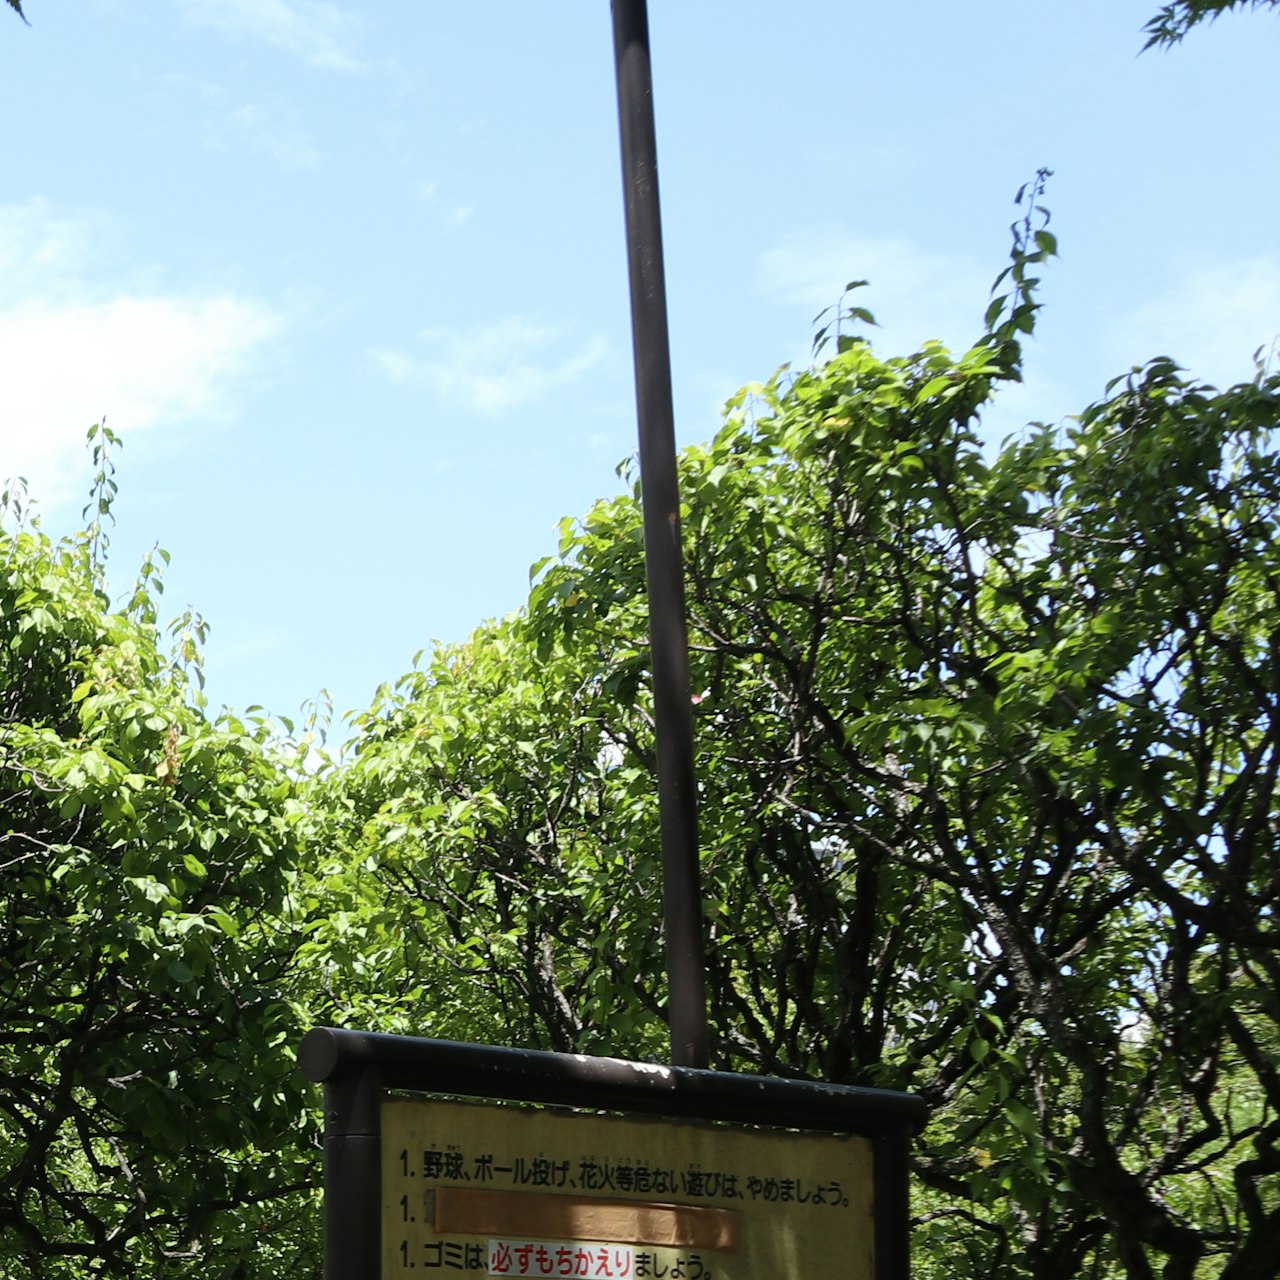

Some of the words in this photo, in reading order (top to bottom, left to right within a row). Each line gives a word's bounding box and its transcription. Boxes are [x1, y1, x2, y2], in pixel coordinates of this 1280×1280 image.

[399, 1149, 416, 1178] 1.
[423, 1150, 850, 1208] 野球、ボール投げ、花火等危ない遊びは、やめましょう。
[399, 1194, 416, 1223] 1.
[399, 1239, 416, 1268] 1.
